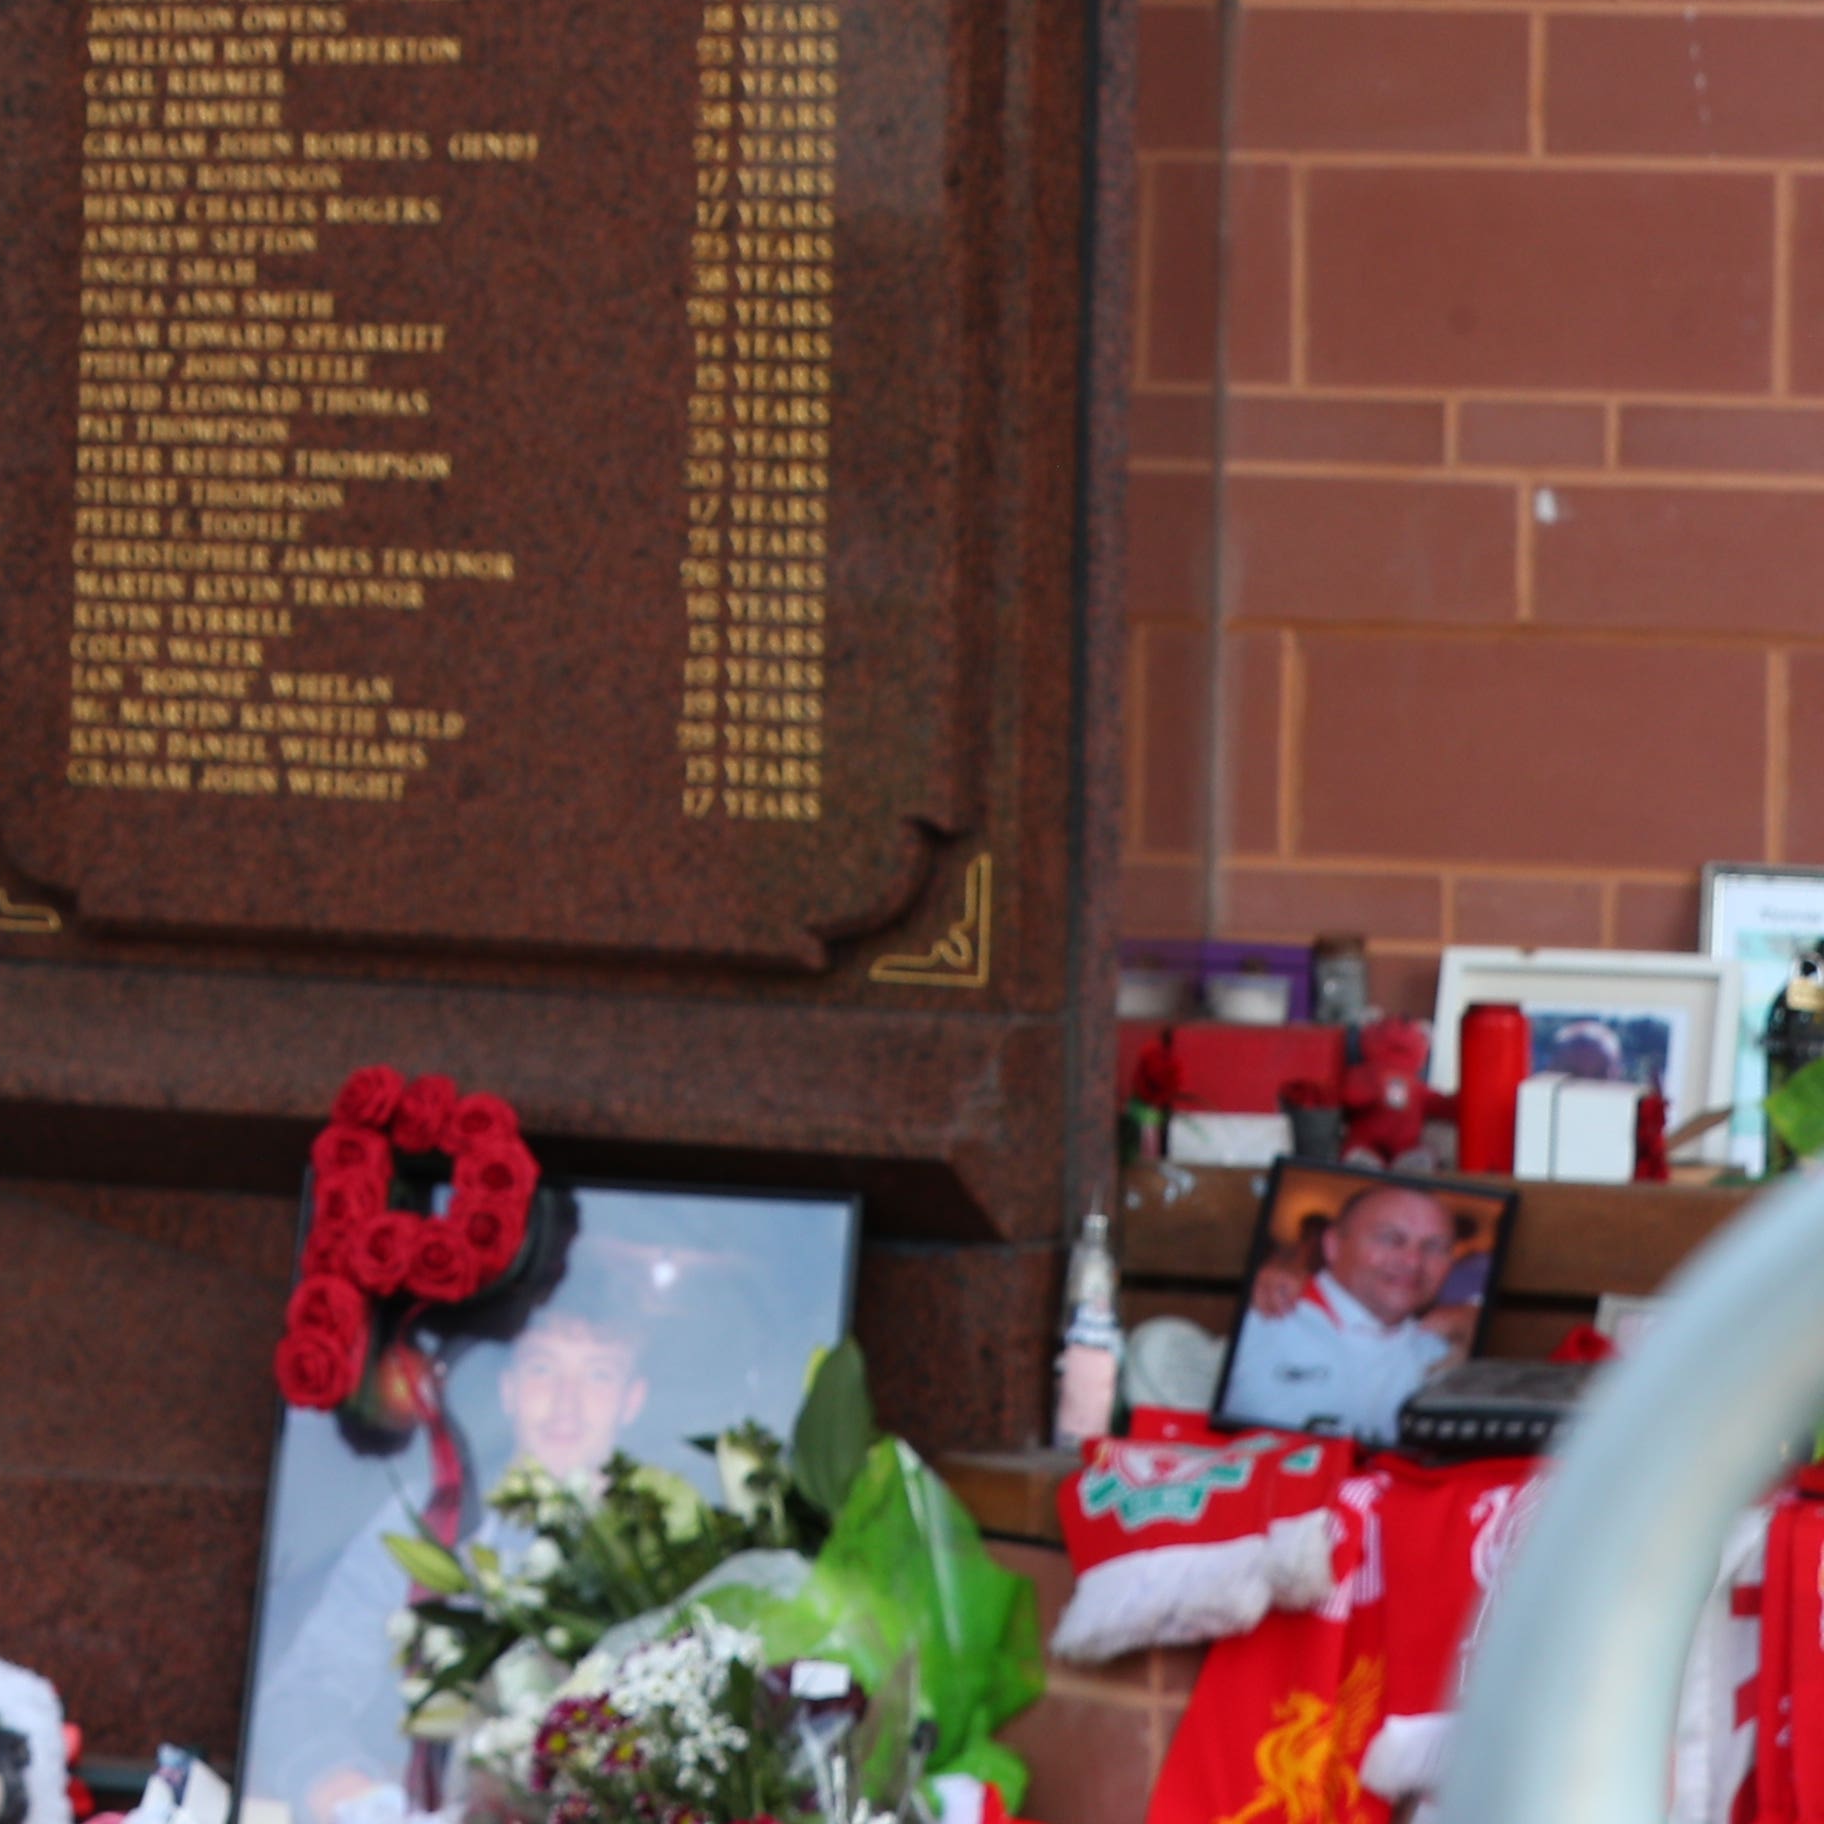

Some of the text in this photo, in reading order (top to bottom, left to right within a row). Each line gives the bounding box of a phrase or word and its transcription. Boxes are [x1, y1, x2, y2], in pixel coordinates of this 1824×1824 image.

[75, 381, 433, 418] DAVID LEONARD THOMAS
[71, 568, 427, 611] MARTIN KEVIN TRAYNOR
[62, 757, 409, 802] GRAHAM JOHN WRIGHT
[720, 788, 825, 822] YEARS
